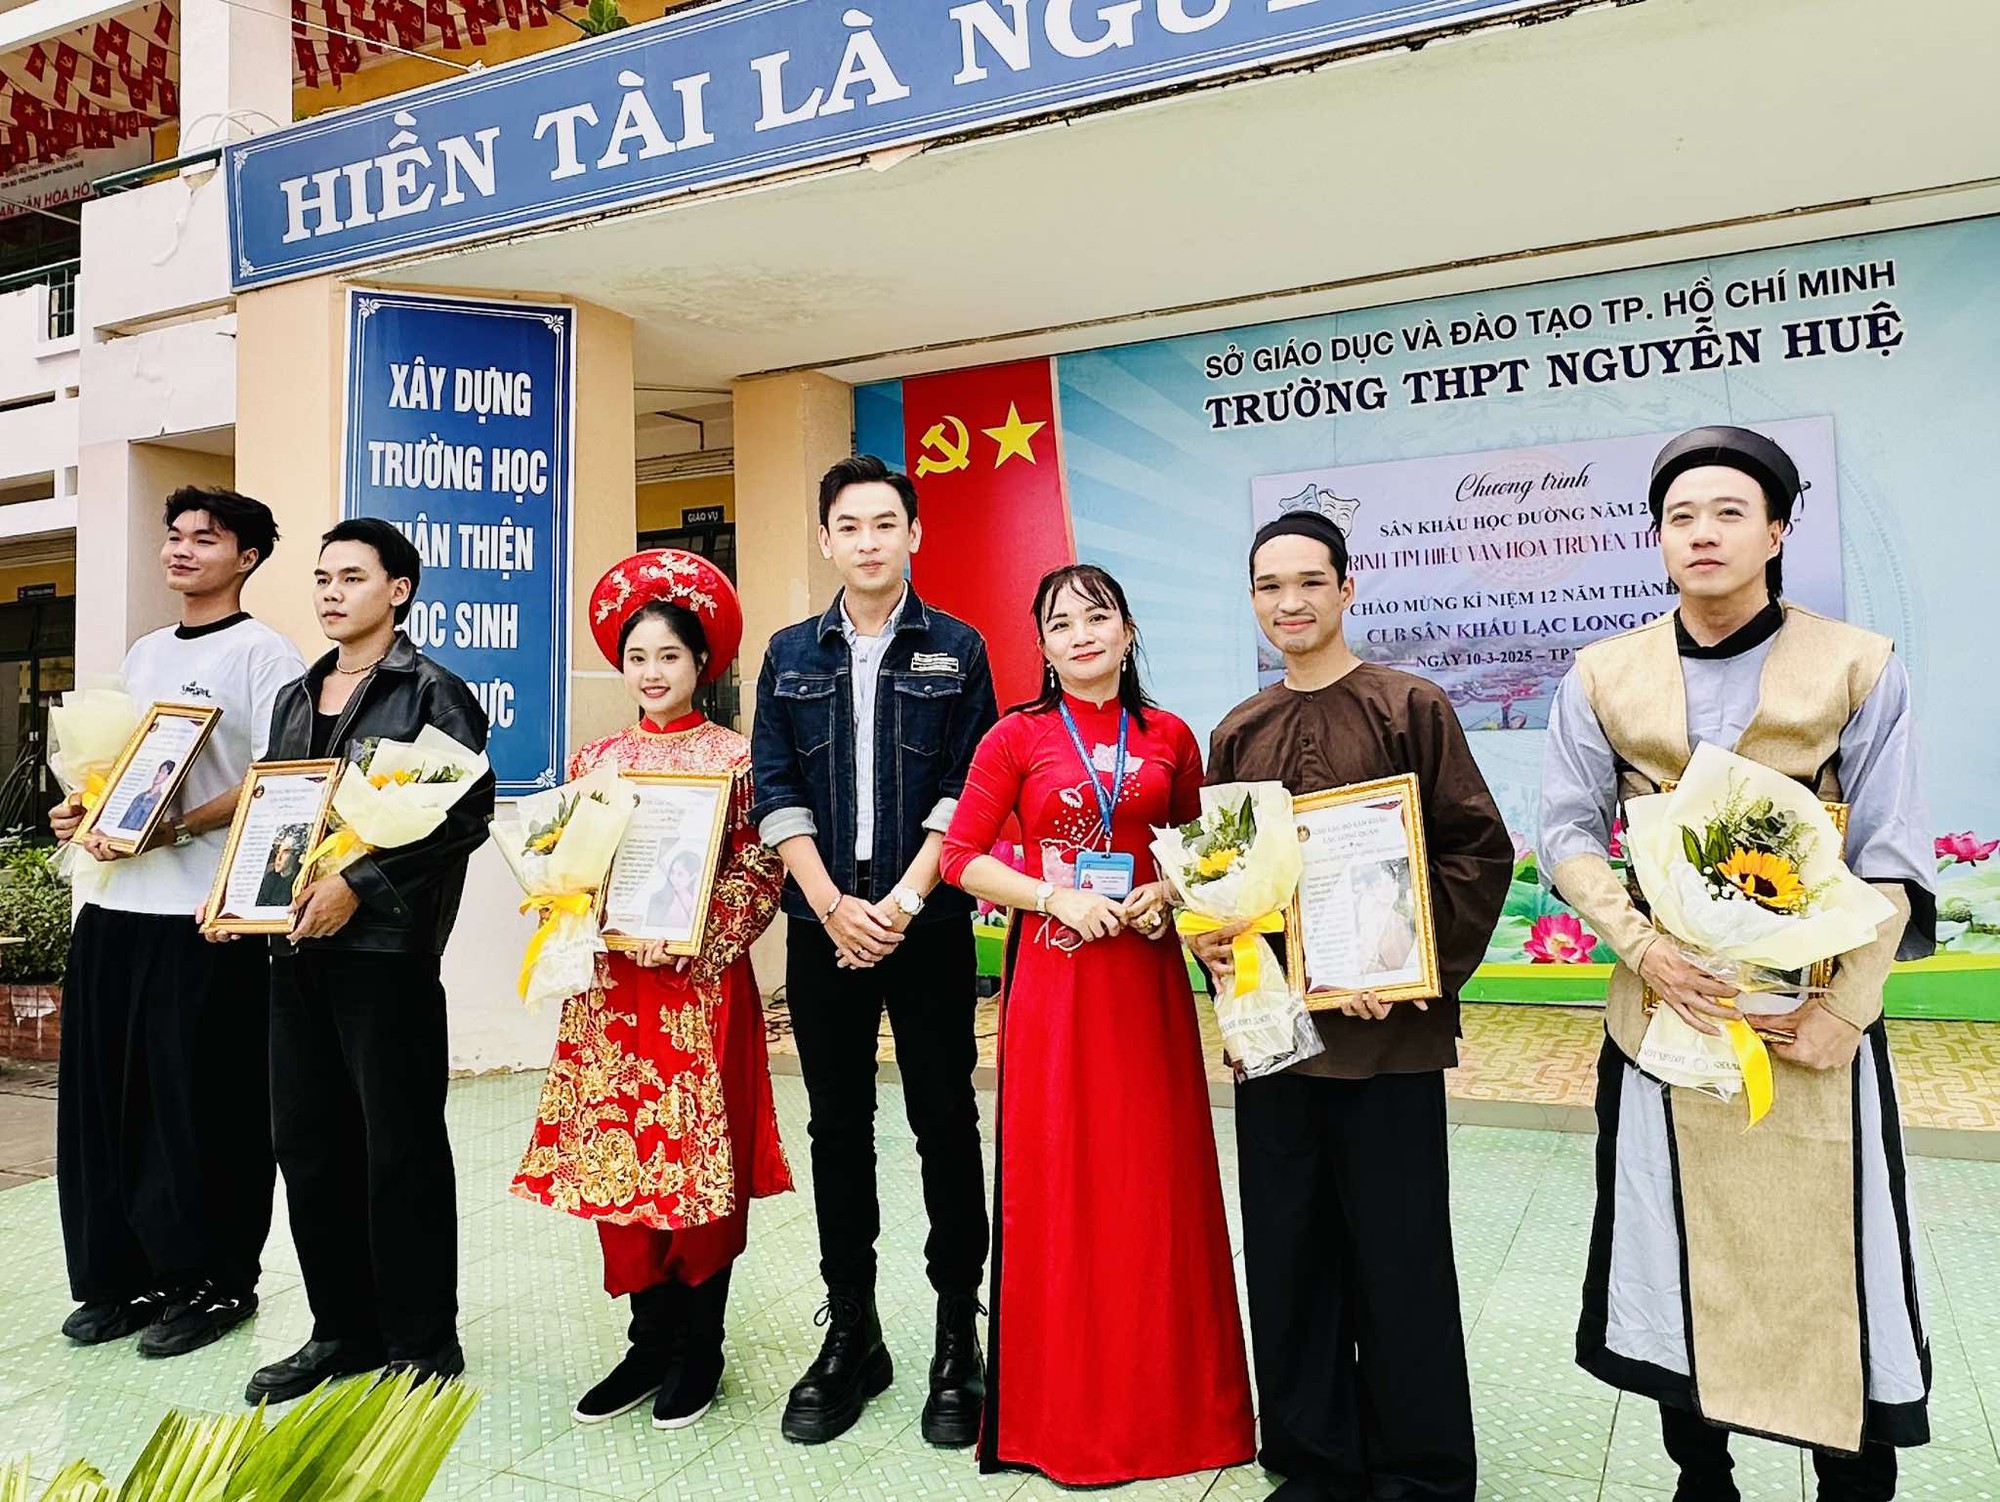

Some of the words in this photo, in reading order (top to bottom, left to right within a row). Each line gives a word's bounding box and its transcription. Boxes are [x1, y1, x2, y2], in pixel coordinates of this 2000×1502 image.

[280, 110, 500, 243] HIỀN
[533, 70, 715, 181] TÀI
[750, 7, 909, 132] LÀ
[949, 0, 1284, 85] NG
[1205, 345, 1245, 379] SỞ
[1253, 338, 1322, 371] GIÁO
[1331, 331, 1394, 366] DỤC
[1402, 319, 1442, 351] VÀ
[1450, 311, 1517, 346] ĐÀO
[1526, 303, 1592, 339] TẠO
[1601, 296, 1653, 325] TP.
[1664, 276, 1714, 317] HỒ
[1725, 268, 1787, 308] CHÍ
[1798, 260, 1895, 299] MINH
[388, 356, 447, 411] XÂY
[454, 366, 532, 424] DỰNG
[1204, 377, 1388, 429] TRƯỜNG
[1402, 358, 1530, 405] THPT
[1547, 315, 1762, 389] NGUYỄN
[1782, 301, 1904, 357] HUỆ
[368, 433, 483, 492] TRƯỜNG
[492, 448, 548, 504] HỌC
[1541, 462, 1597, 491] trình
[389, 512, 450, 569] ÂN
[458, 516, 534, 580] THIỆN
[1380, 520, 1413, 537] SÂN
[1474, 513, 1512, 531] HỌC
[1518, 506, 1585, 525] ĐƯỜNG
[1590, 502, 1634, 520] NĂM
[396, 601, 447, 654] ỌC
[454, 602, 519, 649] SINH
[1350, 598, 1399, 616] CHÀO
[1404, 595, 1458, 612] MỪNG
[1487, 590, 1534, 608] NIỆM
[1541, 589, 1557, 603] 12
[1563, 585, 1605, 601] NĂM
[1367, 628, 1407, 644] CLB
[1412, 621, 1450, 642] SÂN
[1524, 617, 1567, 637] LẠC
[1573, 613, 1635, 632] LONG
[1416, 651, 1461, 668] NGÀY
[1466, 650, 1533, 665] 10-3-2025
